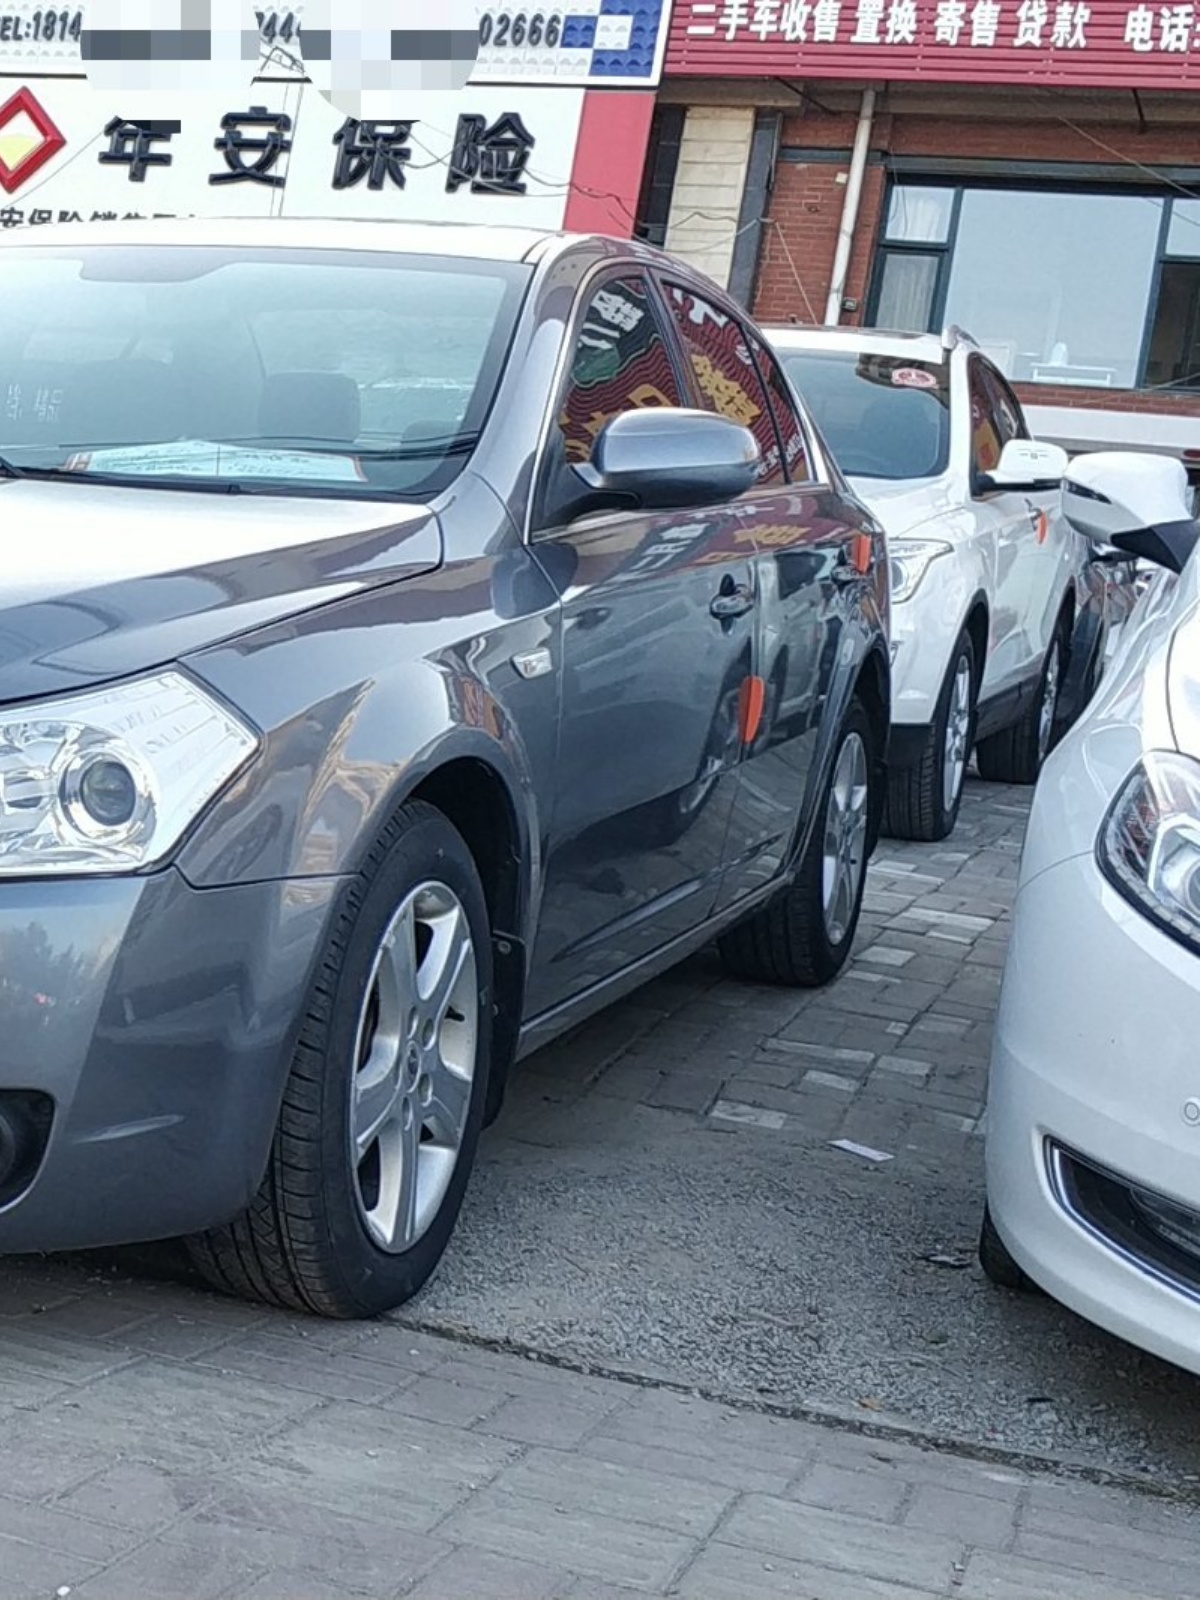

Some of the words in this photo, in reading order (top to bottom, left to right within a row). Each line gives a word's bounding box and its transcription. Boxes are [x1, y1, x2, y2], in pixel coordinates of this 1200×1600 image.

[687, 0, 841, 41] 二手车收售
[850, 0, 917, 43] 置换
[934, 0, 1001, 46] 寄售
[1013, 1, 1090, 48] 贷款
[98, 106, 535, 194] 年安保险
